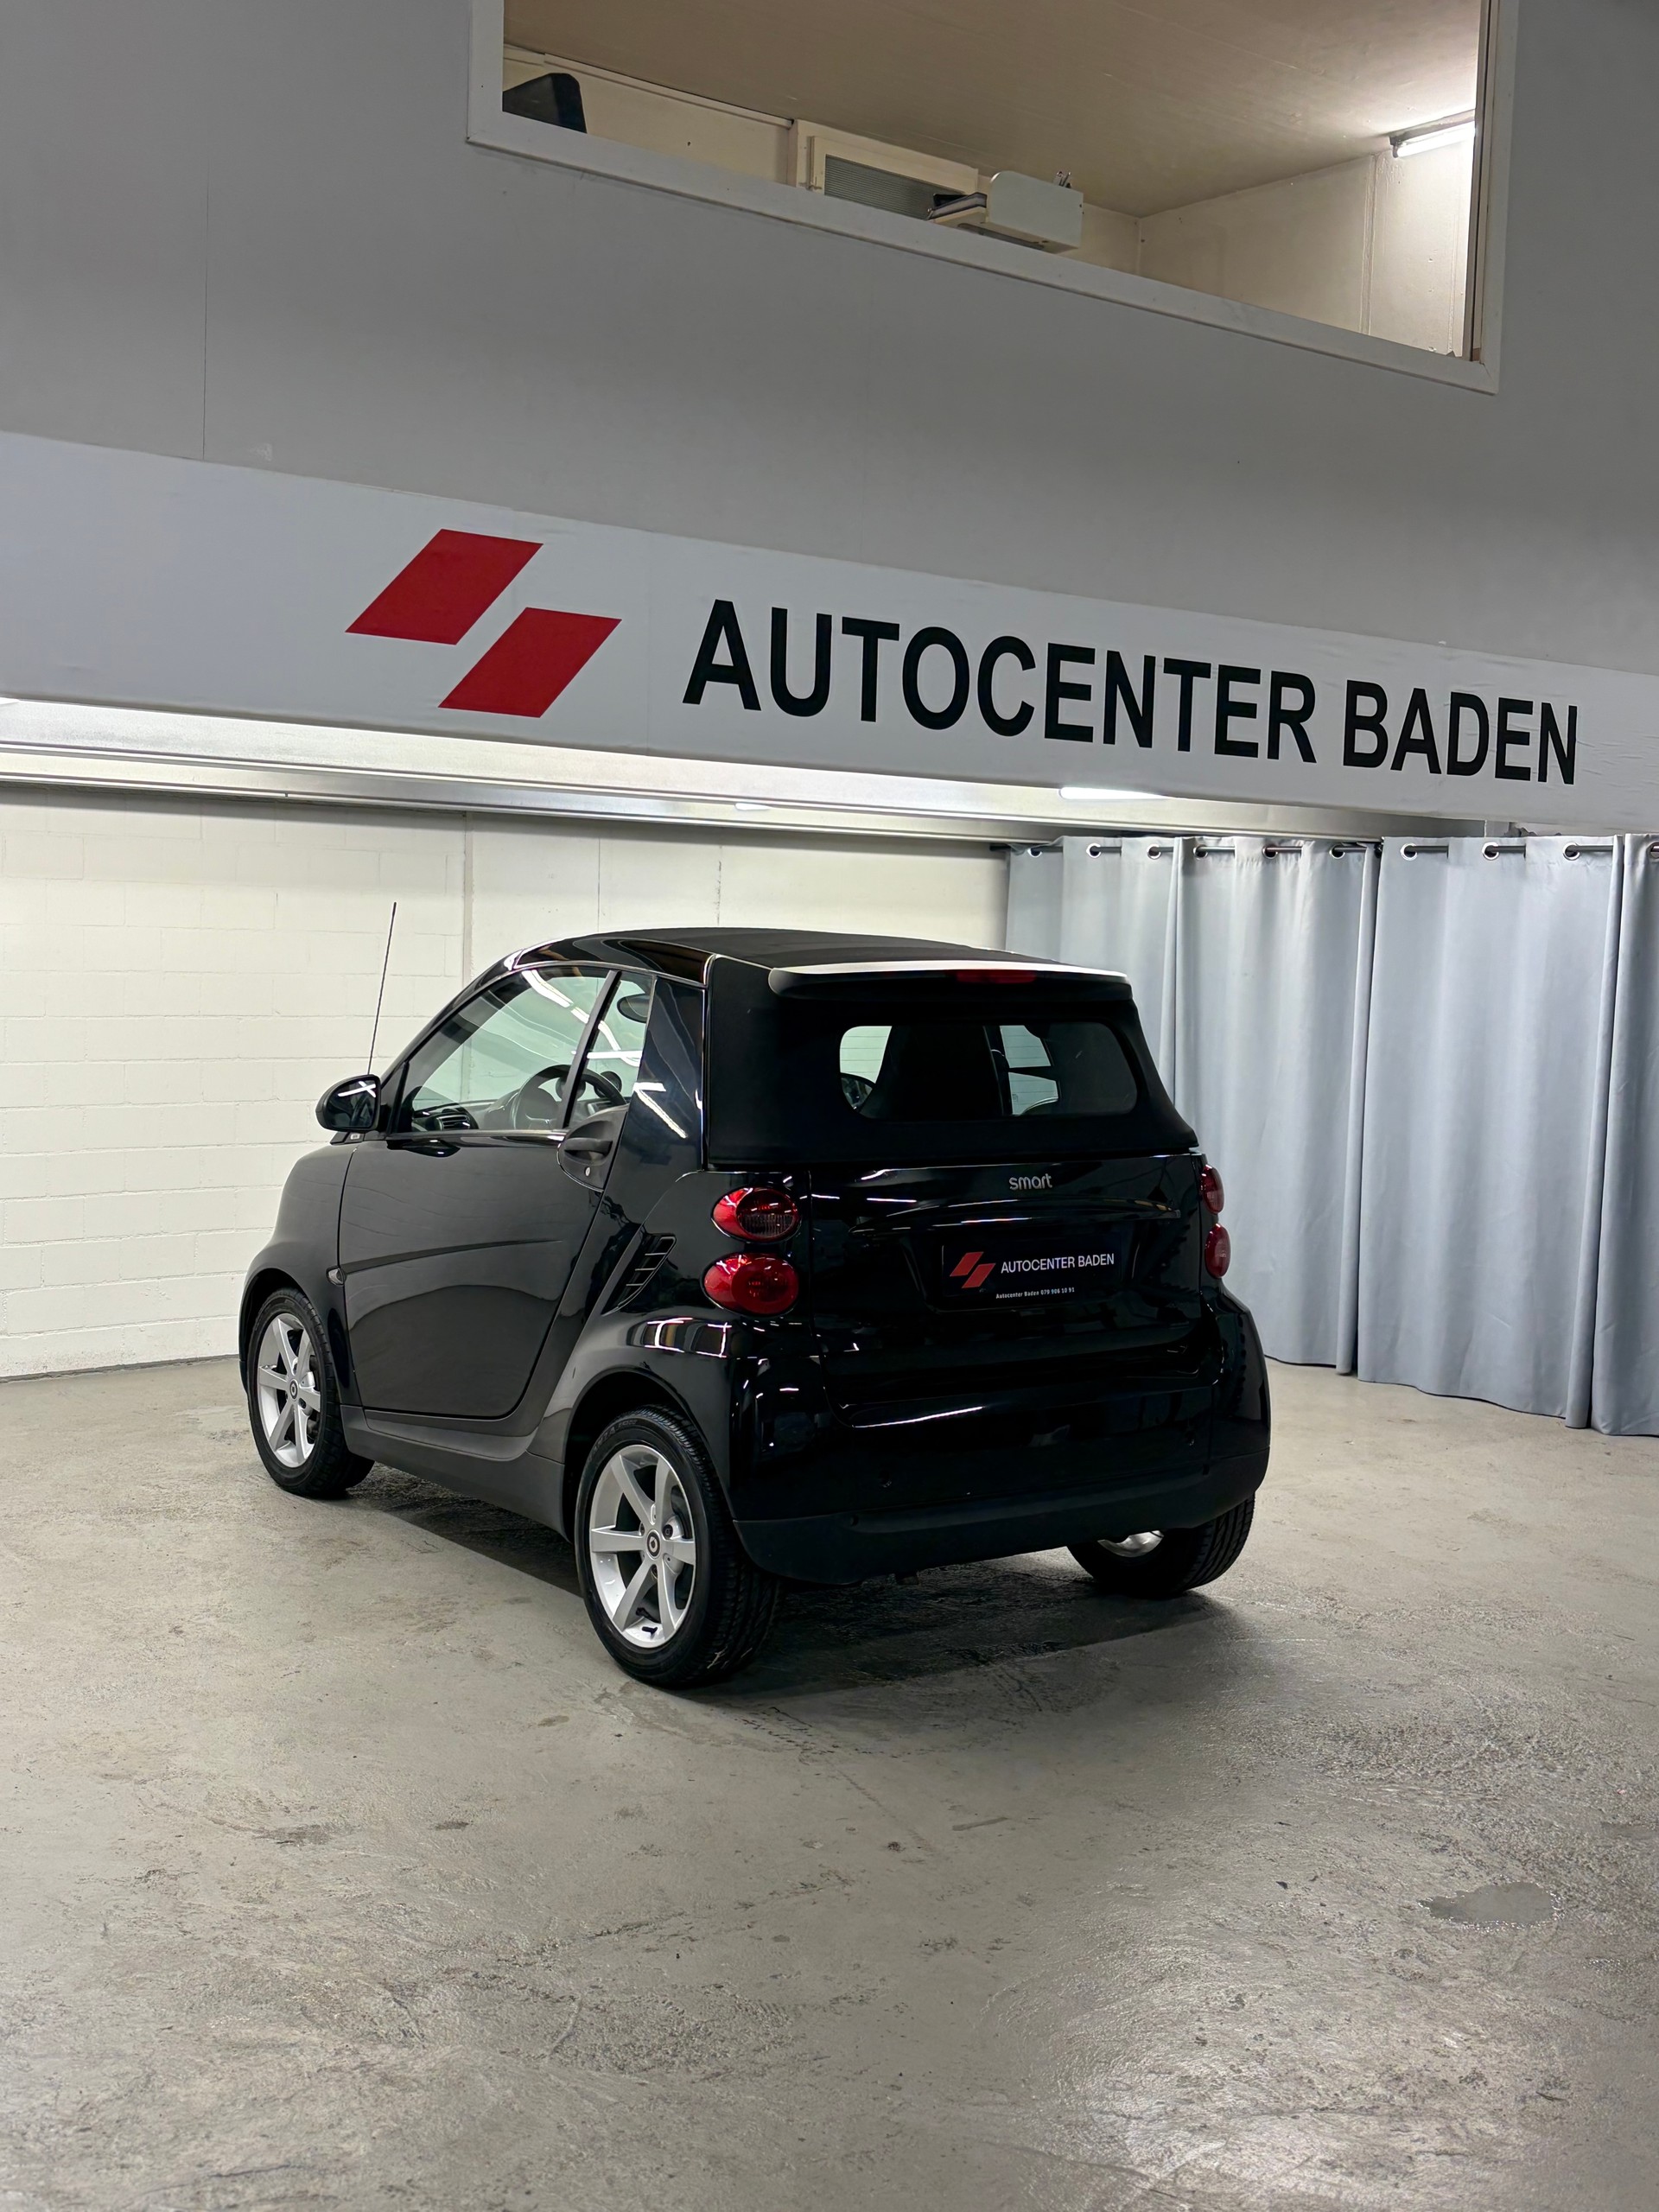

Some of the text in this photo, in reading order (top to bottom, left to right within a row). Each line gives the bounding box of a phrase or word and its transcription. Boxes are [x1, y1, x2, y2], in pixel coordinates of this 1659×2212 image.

[682, 599, 1578, 785] AUTOCENTER BADEN
[1008, 1173, 1053, 1191] smart
[1001, 1253, 1115, 1274] AUTOCENTER BADEN
[995, 1291, 1023, 1300] Autocenter
